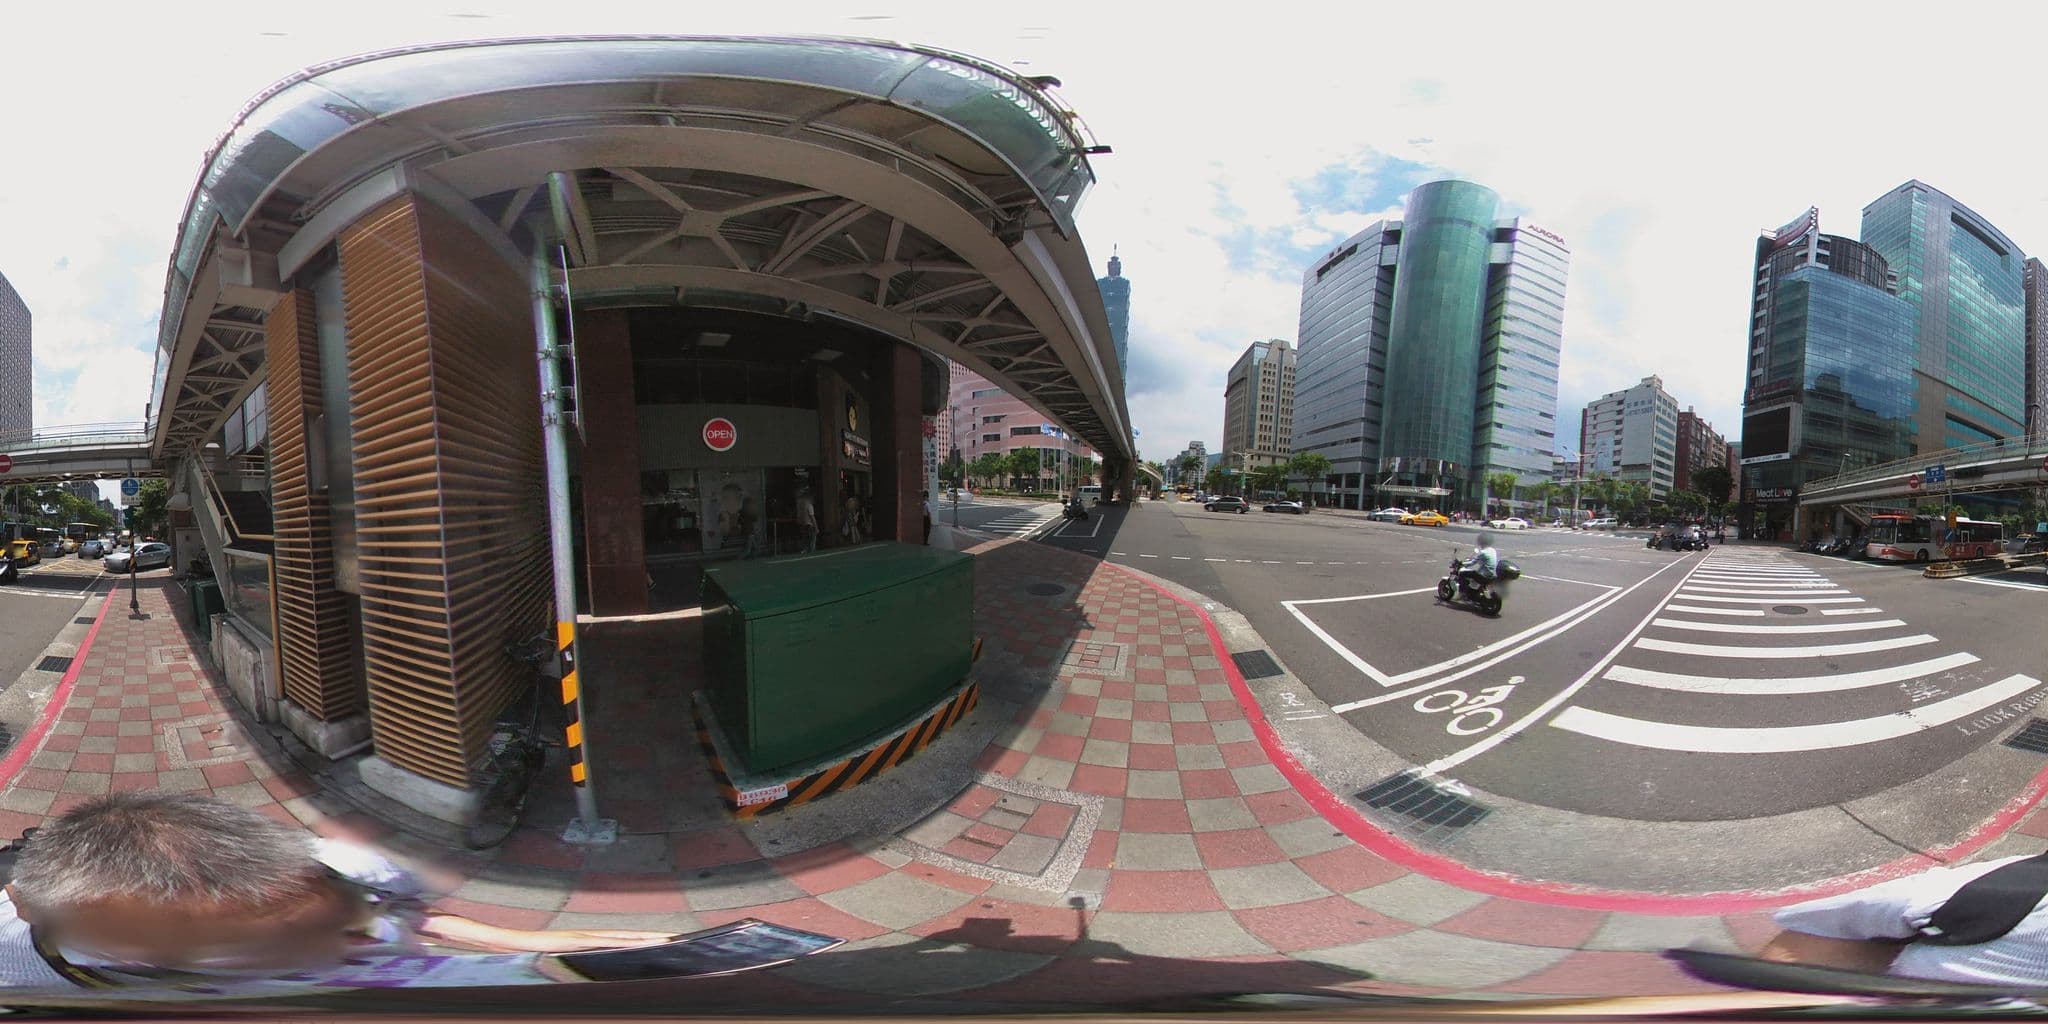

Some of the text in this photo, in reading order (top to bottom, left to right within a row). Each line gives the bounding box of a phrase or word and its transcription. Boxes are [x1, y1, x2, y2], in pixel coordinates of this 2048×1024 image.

[1528, 224, 1565, 245] AURORA
[707, 430, 733, 439] OPEN
[1756, 488, 1774, 498] Meat
[1955, 708, 2015, 736] LOOK
